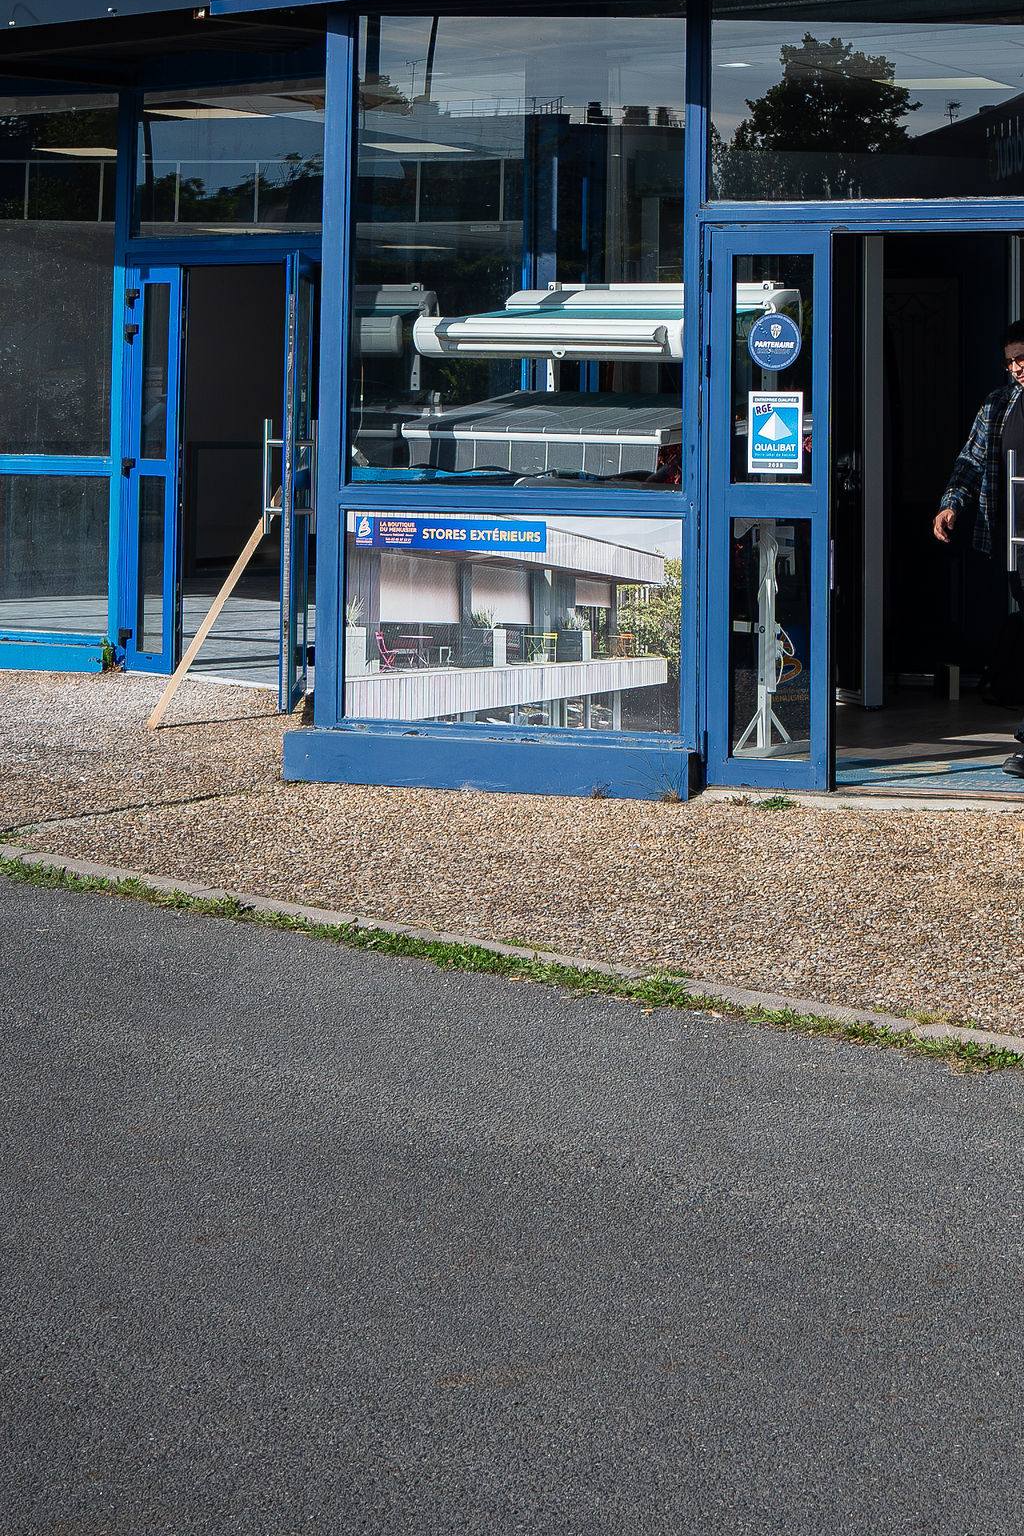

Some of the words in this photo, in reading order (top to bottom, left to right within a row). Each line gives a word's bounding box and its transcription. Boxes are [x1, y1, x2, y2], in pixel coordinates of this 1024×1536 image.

[754, 340, 795, 349] PARTENAIRE
[756, 404, 772, 415] RGE
[754, 443, 796, 452] QUALIBAT
[422, 528, 467, 540] STORES
[470, 527, 541, 543] EXTÉRIEURS
